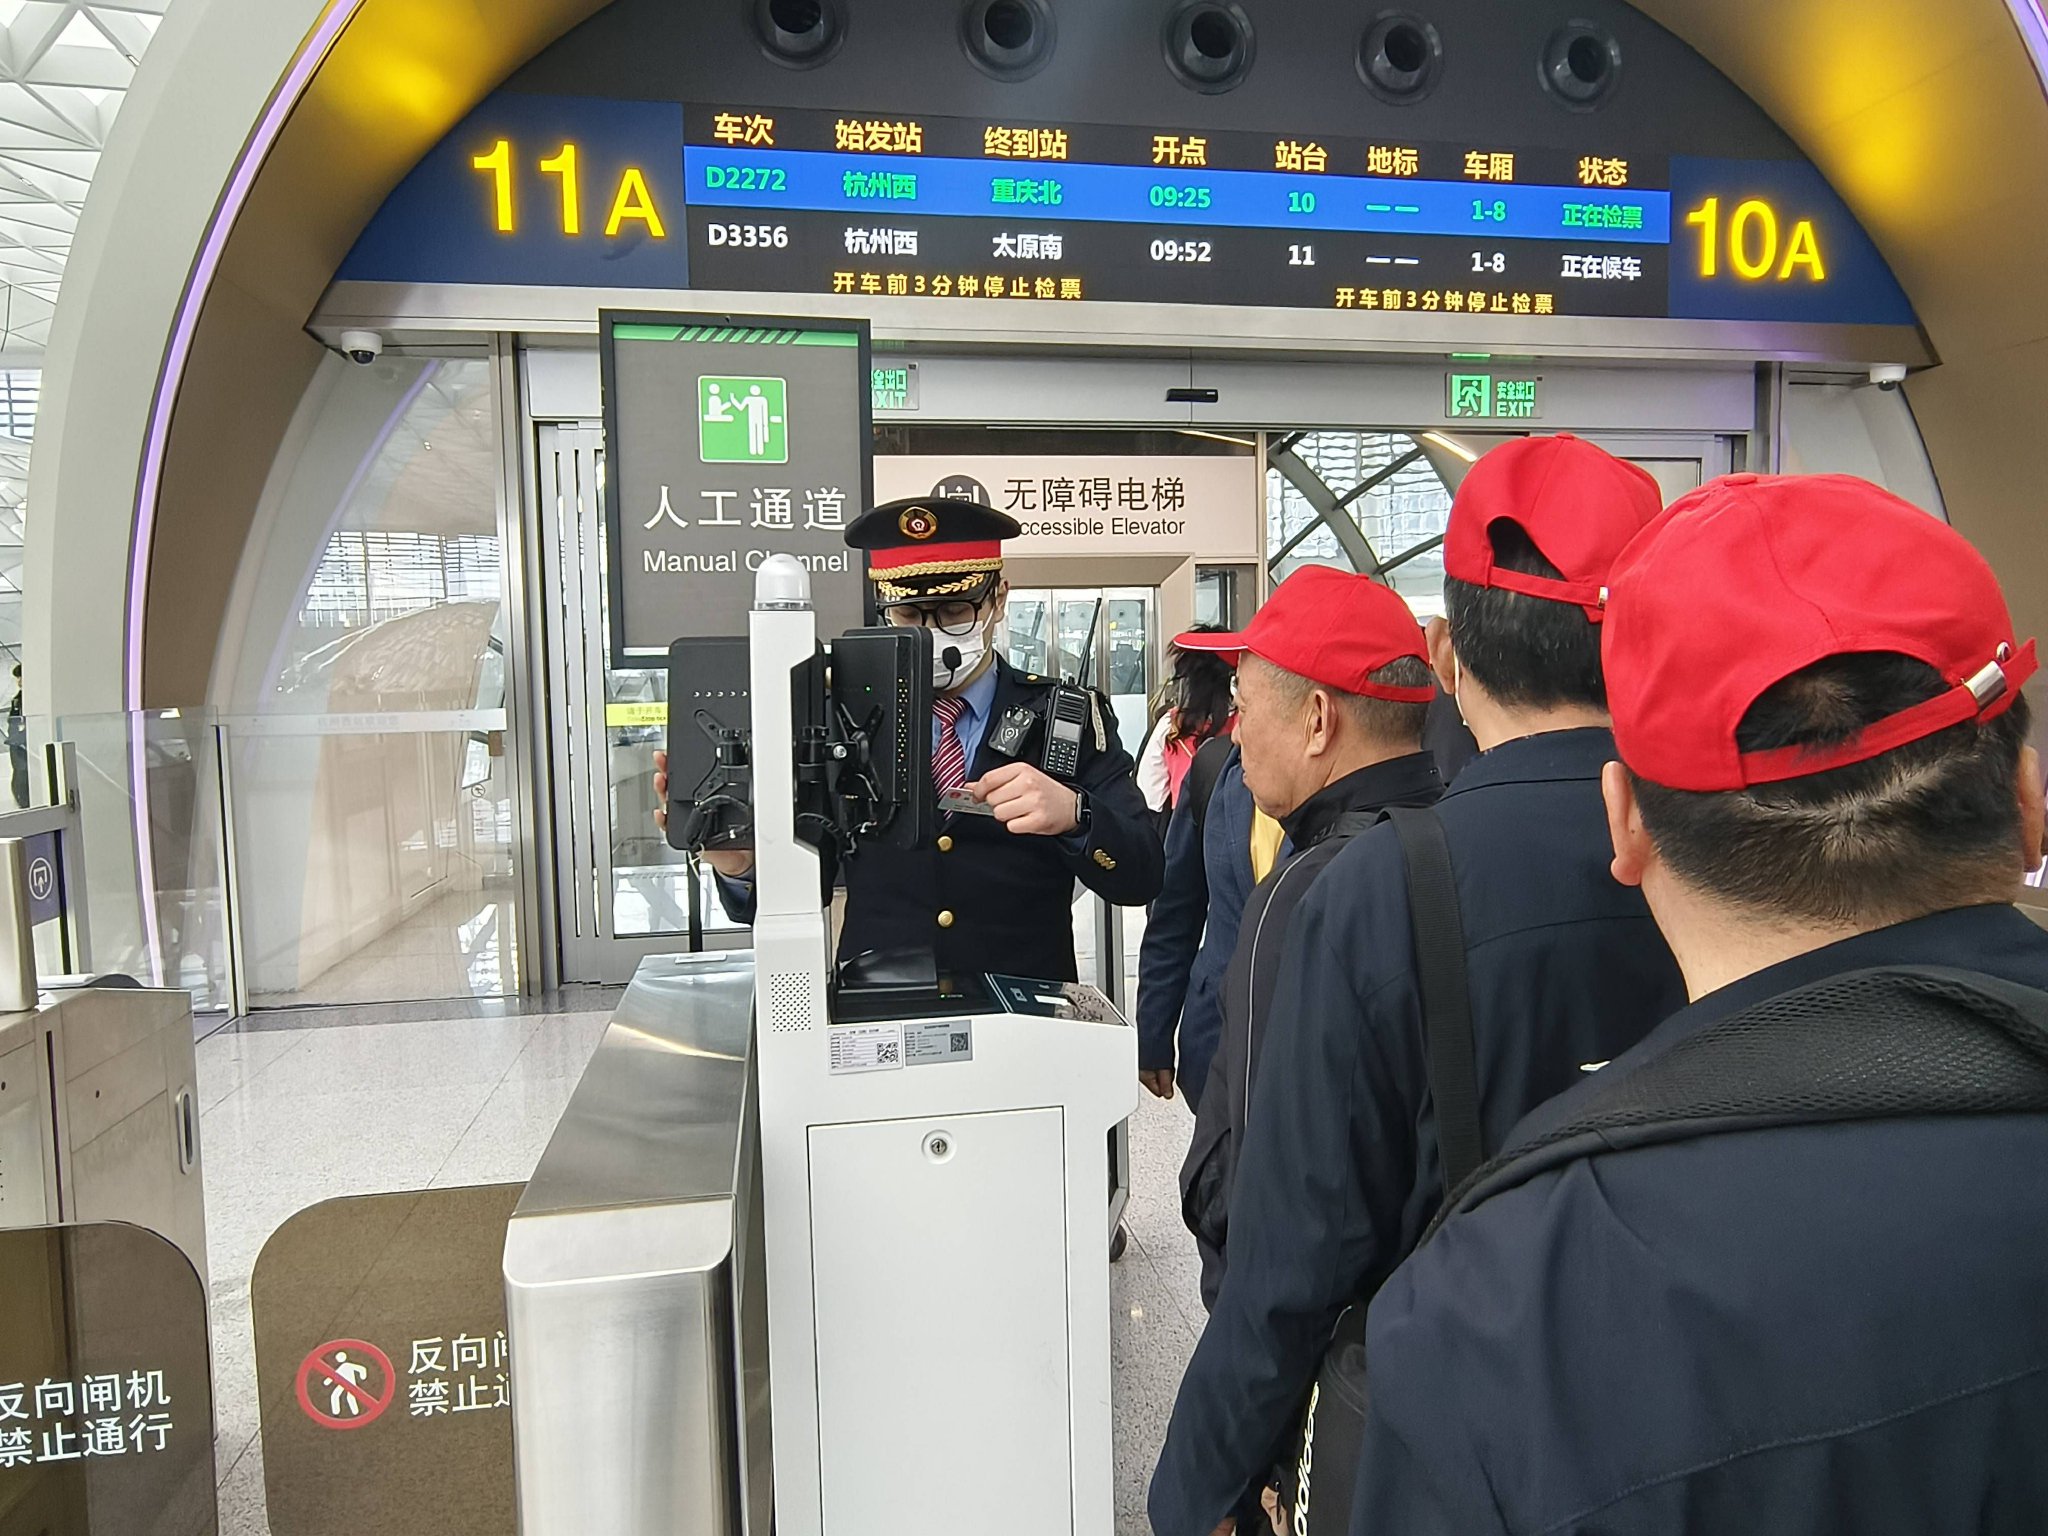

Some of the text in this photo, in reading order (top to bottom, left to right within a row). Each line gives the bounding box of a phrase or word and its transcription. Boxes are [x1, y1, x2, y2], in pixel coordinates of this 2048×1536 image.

[713, 112, 1628, 186] 车次 始发站 终到站 开点 站台 地标 车厢 状态
[706, 166, 786, 192] D2272
[843, 171, 917, 200] 杭州西
[991, 178, 1062, 205] 重庆北
[1149, 185, 1211, 209] 09:25
[1289, 192, 1316, 213] 10
[1472, 200, 1506, 222] 1-8
[1561, 203, 1643, 230] 正在检票
[707, 223, 789, 249] D3356
[844, 227, 918, 256] 杭州西
[992, 232, 1063, 261] 太原南
[1150, 239, 1212, 263] 09:52
[1288, 244, 1316, 266] 11
[1471, 251, 1506, 273] 1-8
[1560, 254, 1642, 281] 正在候车
[832, 270, 1083, 299] 开车前3分钟停止检票
[1335, 287, 1554, 315] 开车前3分钟停止检票
[1496, 401, 1535, 417] EXIT
[643, 485, 847, 532] 人工通道
[1004, 476, 1185, 512] 无障碍电梯
[1020, 517, 1186, 536] ccessible Elevator
[643, 550, 848, 573] Manual Cnnel
[0, 1370, 171, 1421] 反向闸机
[0, 1412, 173, 1468] 禁止通行
